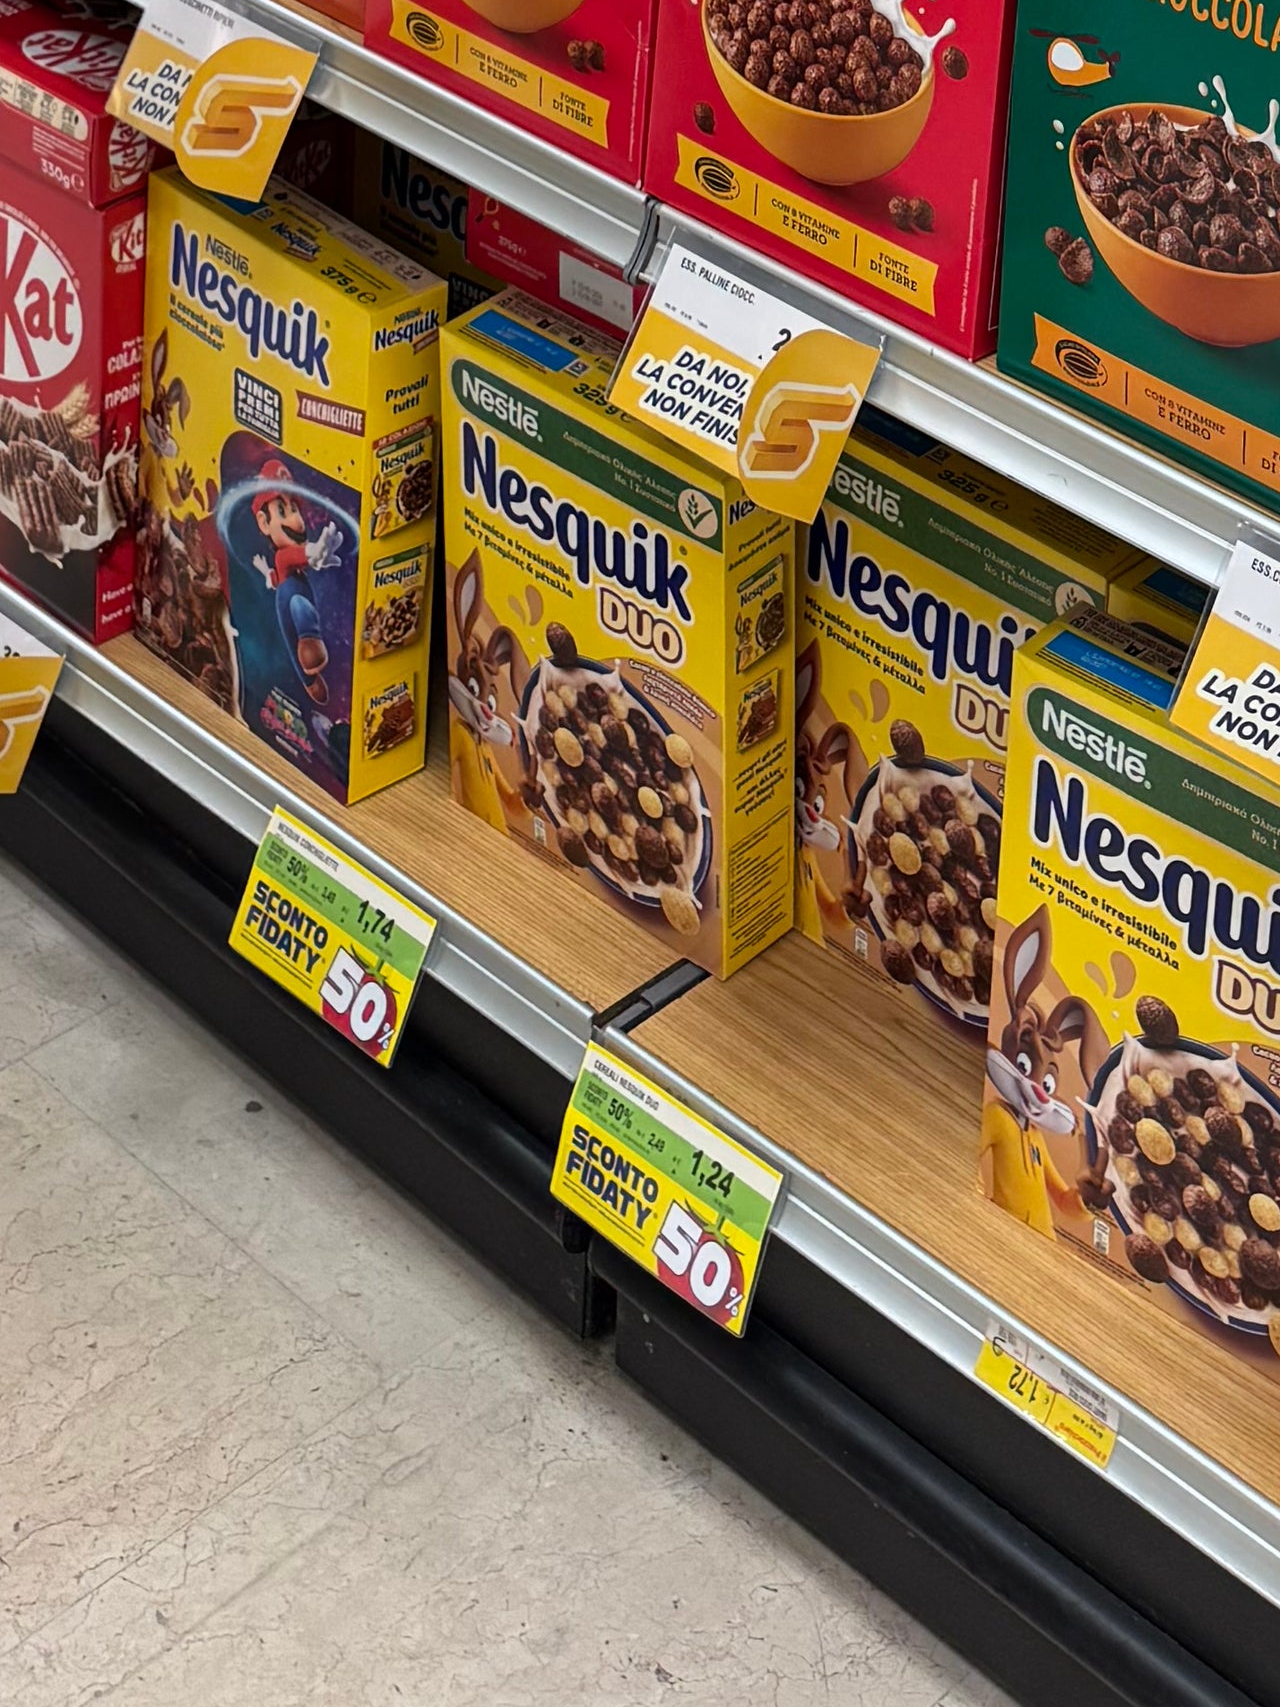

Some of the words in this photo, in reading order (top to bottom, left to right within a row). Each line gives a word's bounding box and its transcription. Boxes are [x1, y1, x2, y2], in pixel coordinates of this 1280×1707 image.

[171, 223, 330, 387] Nesquik
[237, 373, 280, 406] VINCI
[385, 375, 429, 403] Provali
[675, 351, 704, 375] DA
[707, 365, 749, 397] NOI,
[301, 399, 363, 432] CONCHIGLIETTE
[392, 395, 420, 415] tutti
[644, 389, 692, 421] NON
[463, 422, 691, 621] Nesquik
[599, 587, 682, 664] DUO
[1042, 699, 1148, 783] Nestlé
[1216, 711, 1280, 751] NON
[246, 905, 320, 974] FIDATY
[254, 881, 328, 949] SCONTO
[358, 899, 395, 943] 1,74
[608, 1098, 633, 1130] 50%
[572, 1125, 659, 1203] SCONTO
[692, 1149, 735, 1199] 1,24
[566, 1150, 652, 1230] FIDATY
[652, 1199, 744, 1317] 50%
